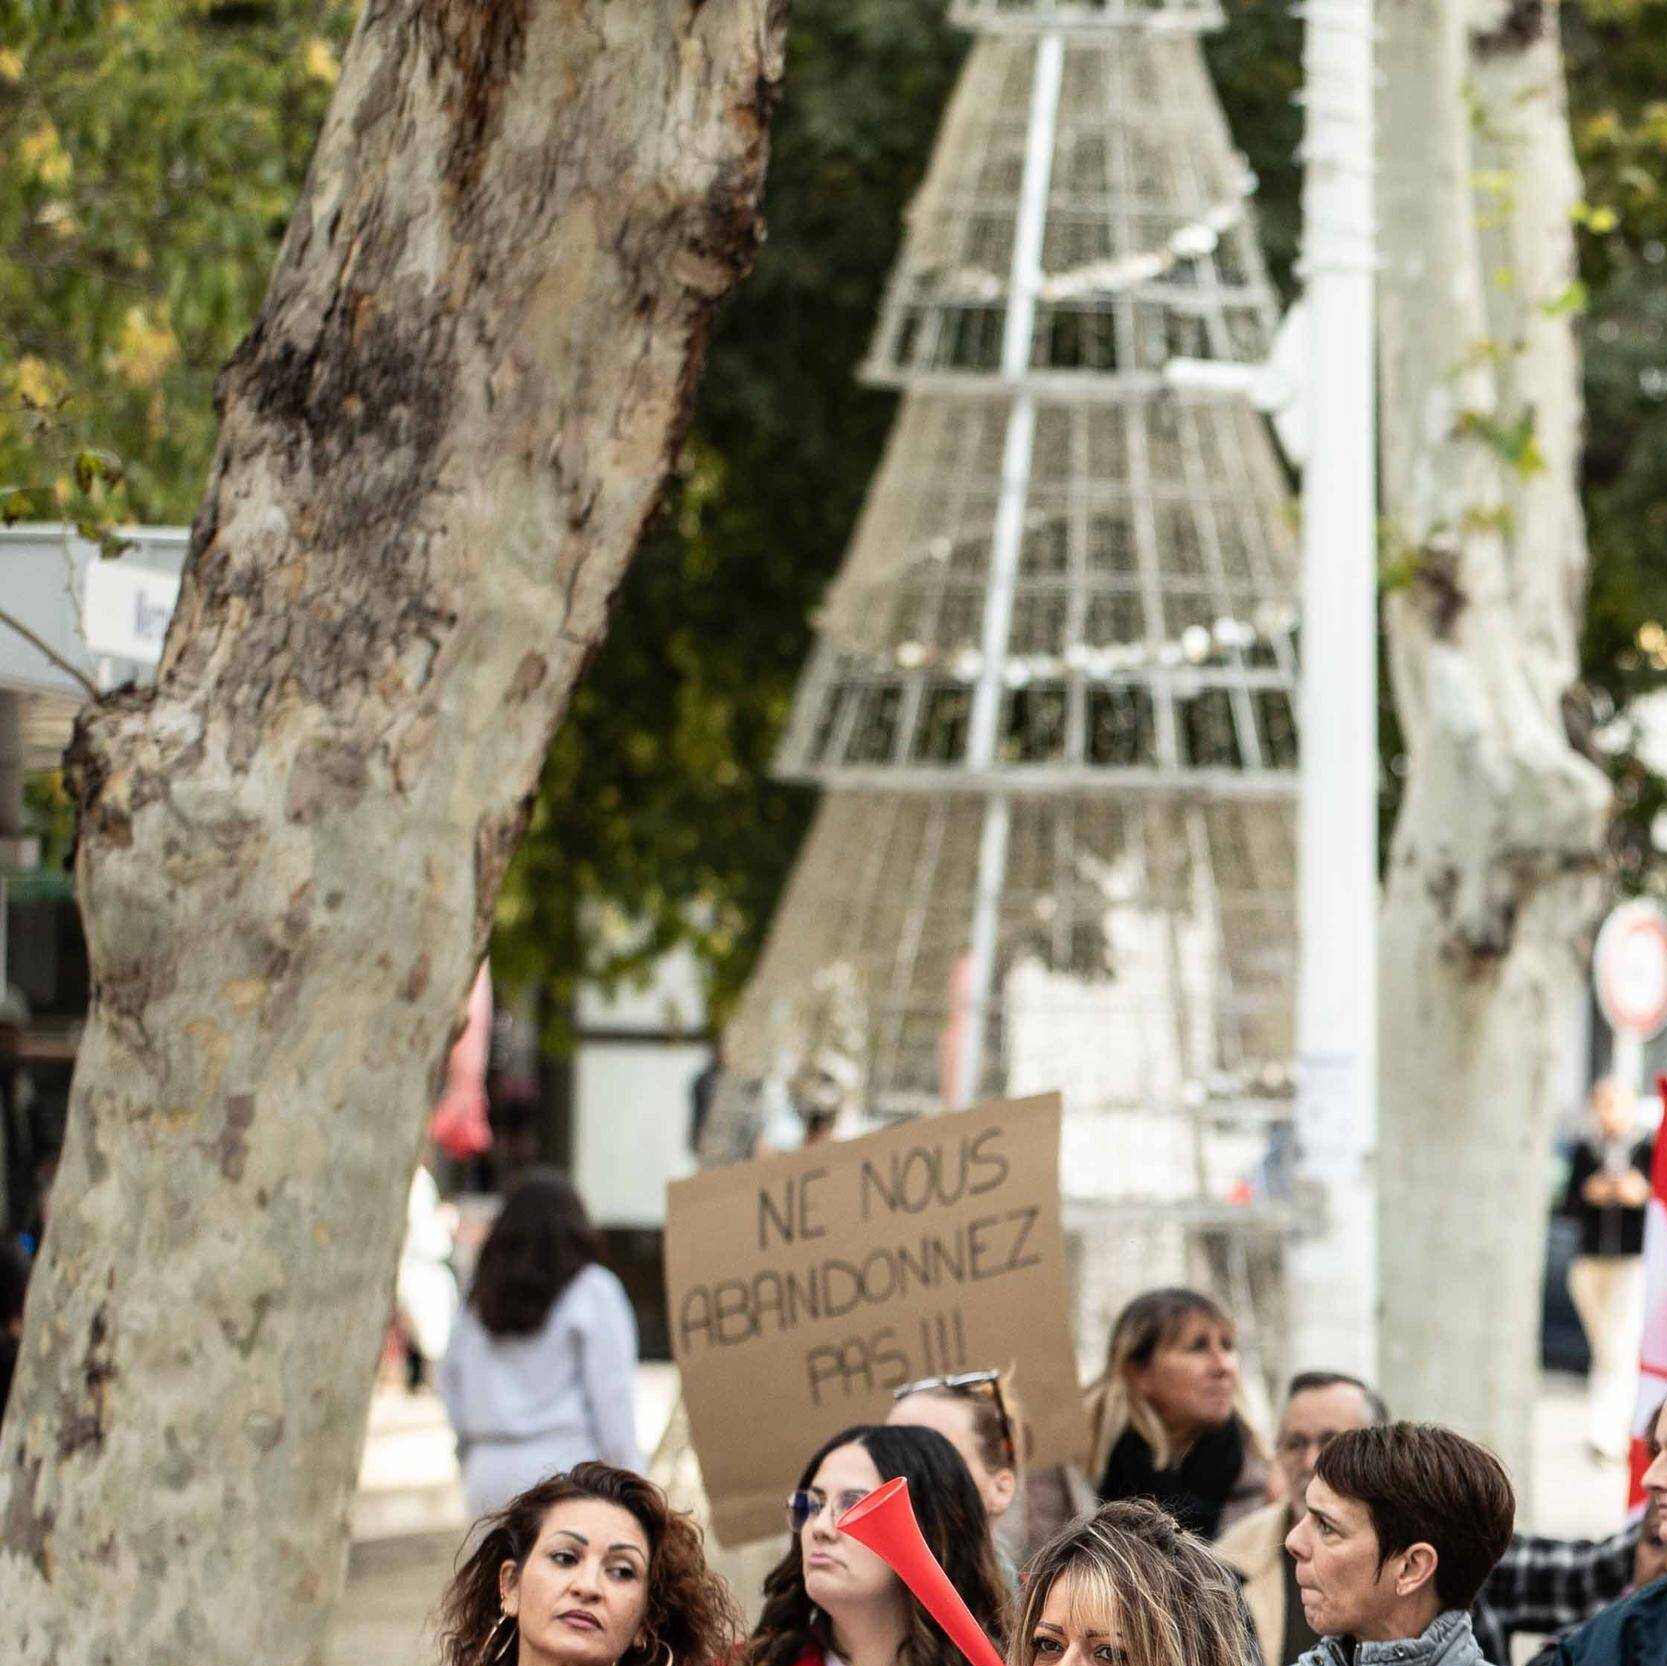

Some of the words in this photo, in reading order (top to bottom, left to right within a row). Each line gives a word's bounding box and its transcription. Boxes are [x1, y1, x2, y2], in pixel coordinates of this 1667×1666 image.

[757, 1167, 828, 1250] NE
[859, 1127, 1010, 1222] NOUS
[680, 1204, 1043, 1355] ABANDONNEZ
[807, 1325, 909, 1404] PAS
